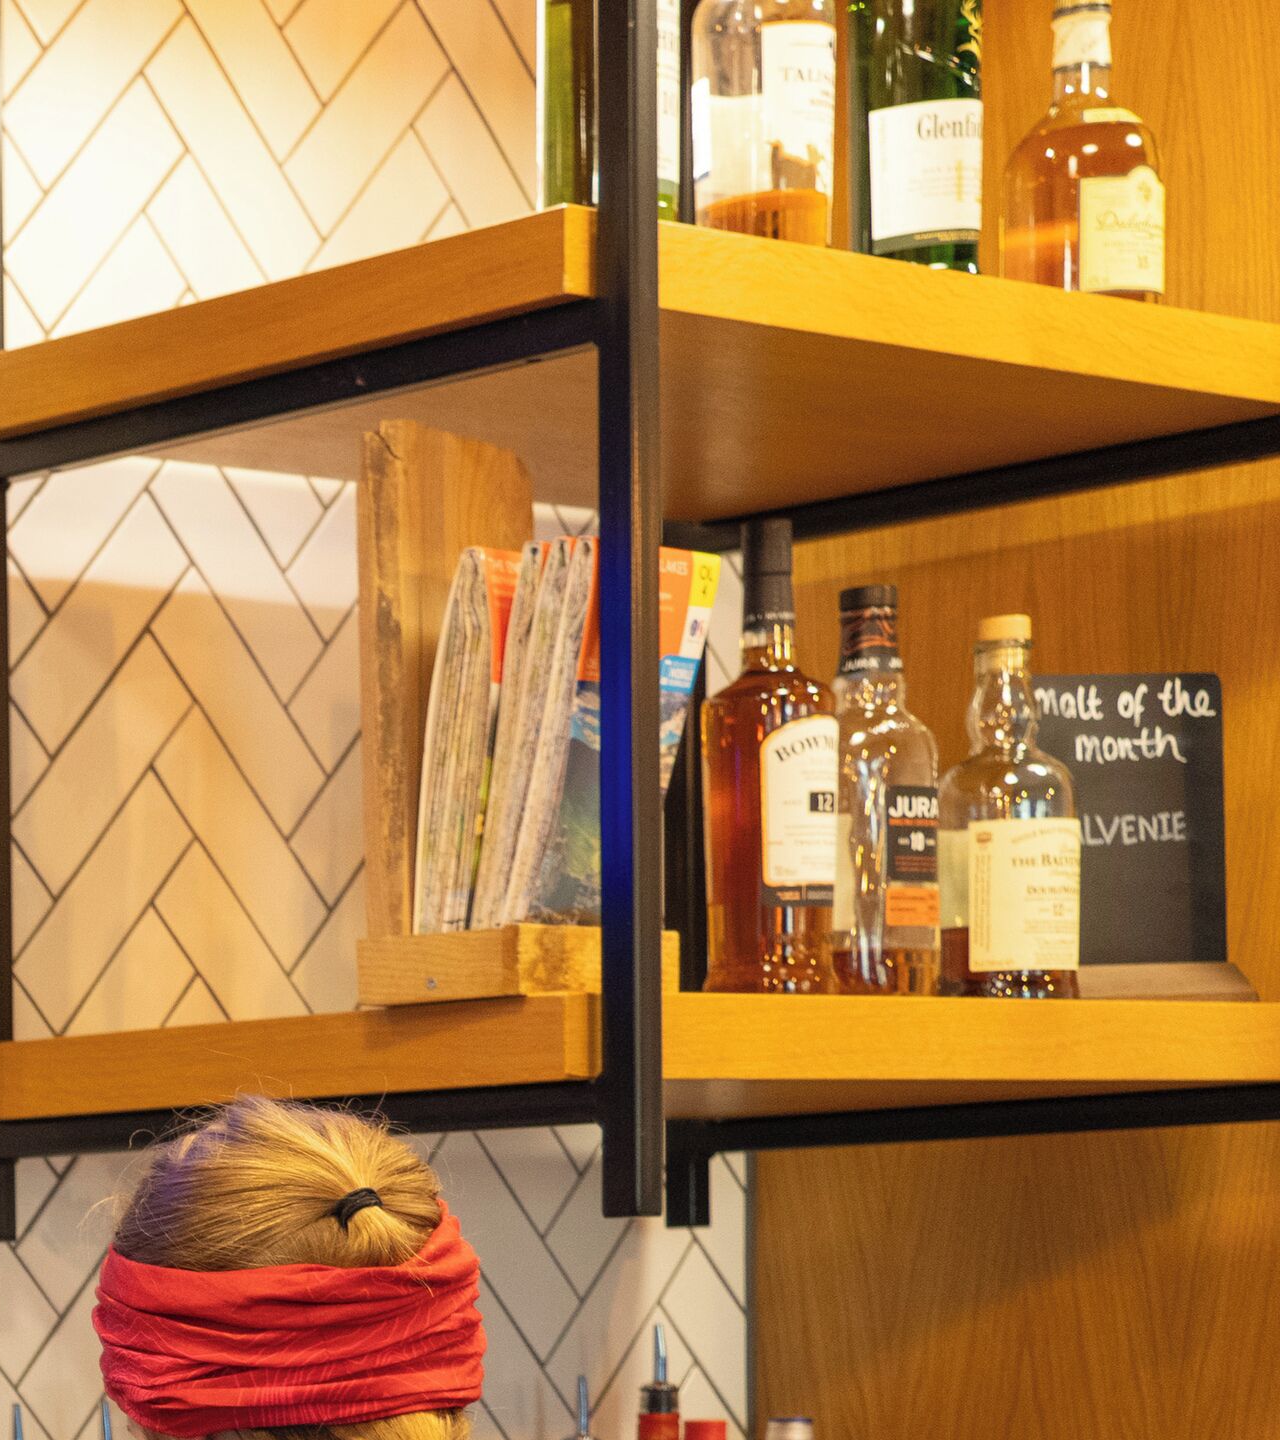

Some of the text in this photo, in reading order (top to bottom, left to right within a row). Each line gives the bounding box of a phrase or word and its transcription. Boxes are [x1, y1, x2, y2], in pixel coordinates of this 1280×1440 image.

[1117, 683, 1149, 727] of
[1158, 678, 1217, 718] the
[1075, 726, 1188, 764] month
[815, 793, 835, 812] 12
[888, 794, 939, 819] JURA
